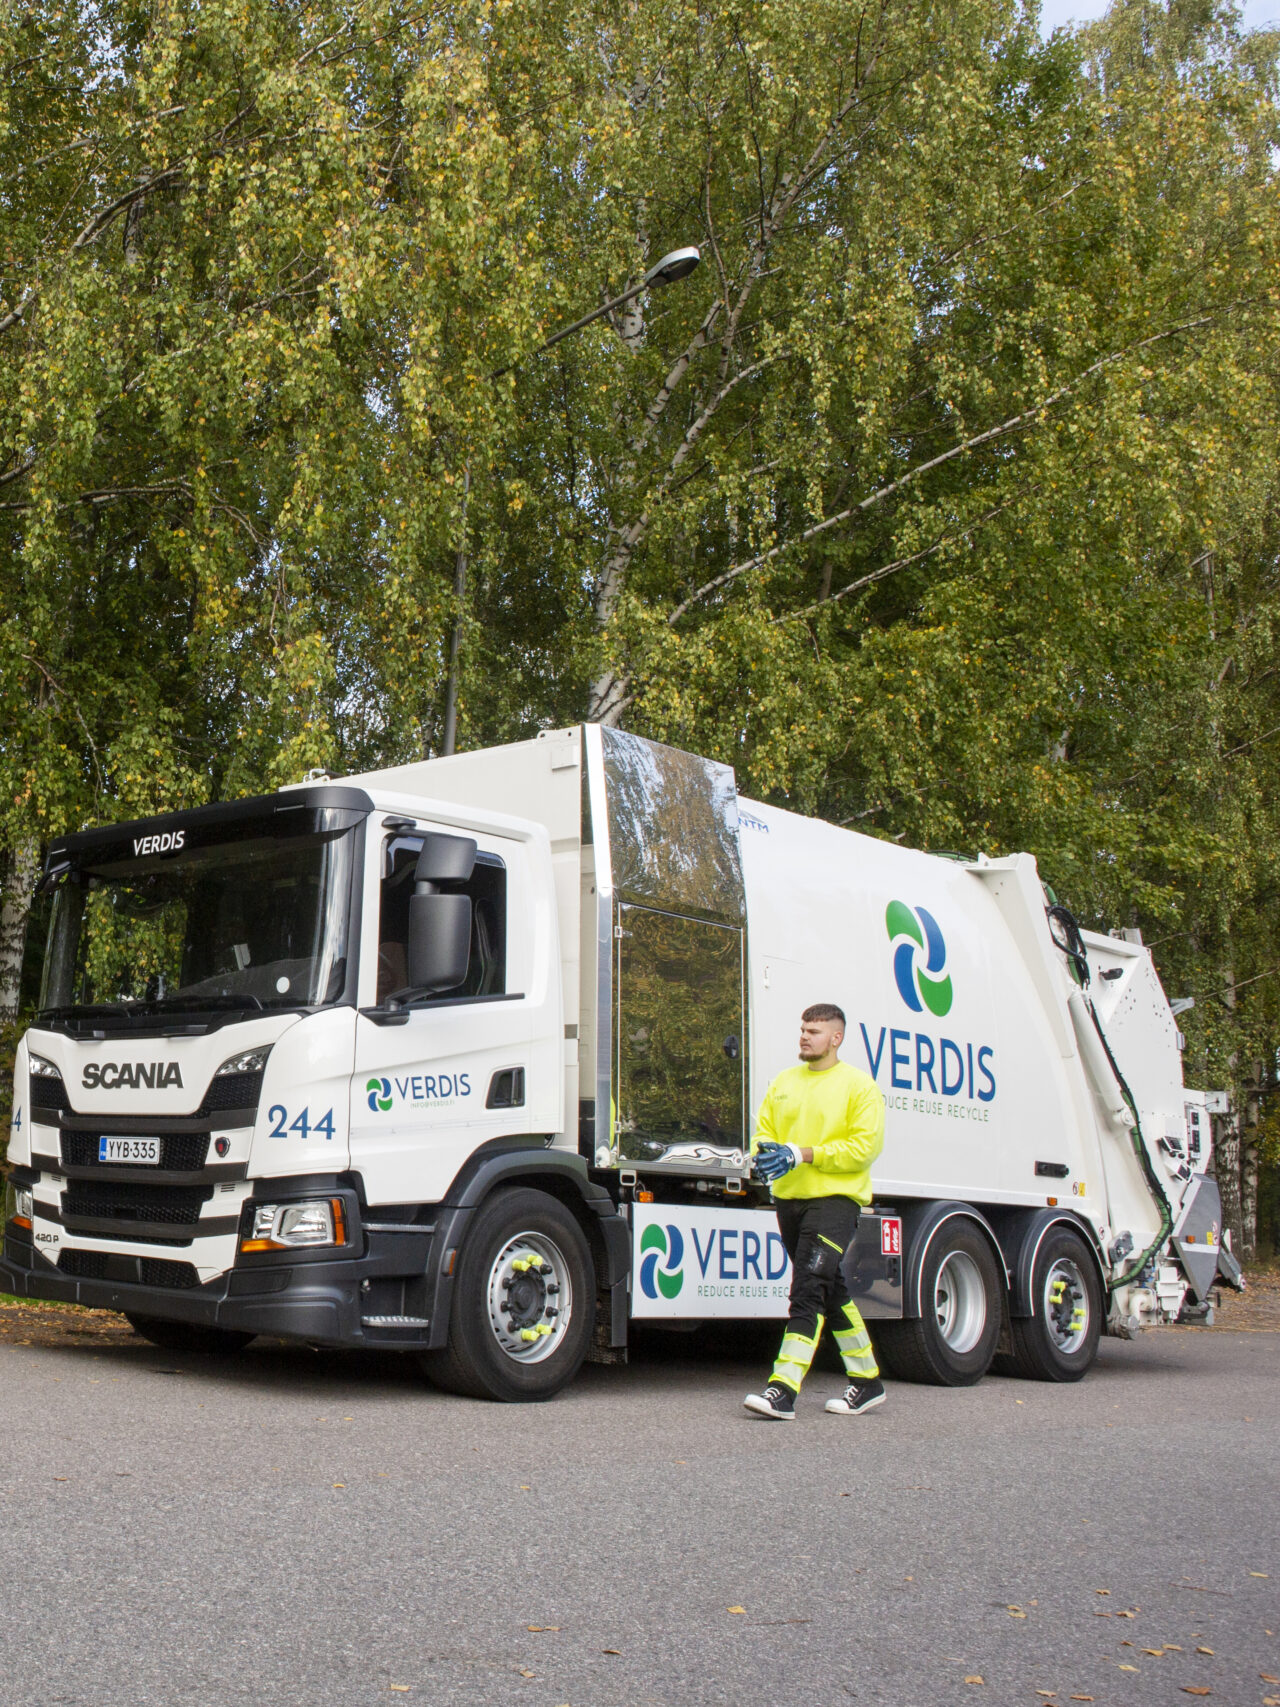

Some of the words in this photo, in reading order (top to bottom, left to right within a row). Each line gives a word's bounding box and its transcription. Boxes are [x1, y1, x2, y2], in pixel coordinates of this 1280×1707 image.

[133, 830, 186, 857] VERDIS
[81, 1062, 184, 1089] SCANIA
[859, 1022, 996, 1102] VERDIS
[394, 1073, 471, 1100] VERDIS
[10, 1105, 22, 1132] 4
[882, 1094, 908, 1111] DUCE
[913, 1098, 943, 1116] REUSE
[947, 1103, 989, 1122] RECYCLE
[268, 1104, 336, 1141] 244
[35, 1232, 52, 1242] 420
[691, 1227, 788, 1281] VERD
[697, 1285, 735, 1297] REDUCE
[740, 1286, 768, 1298] REUSE
